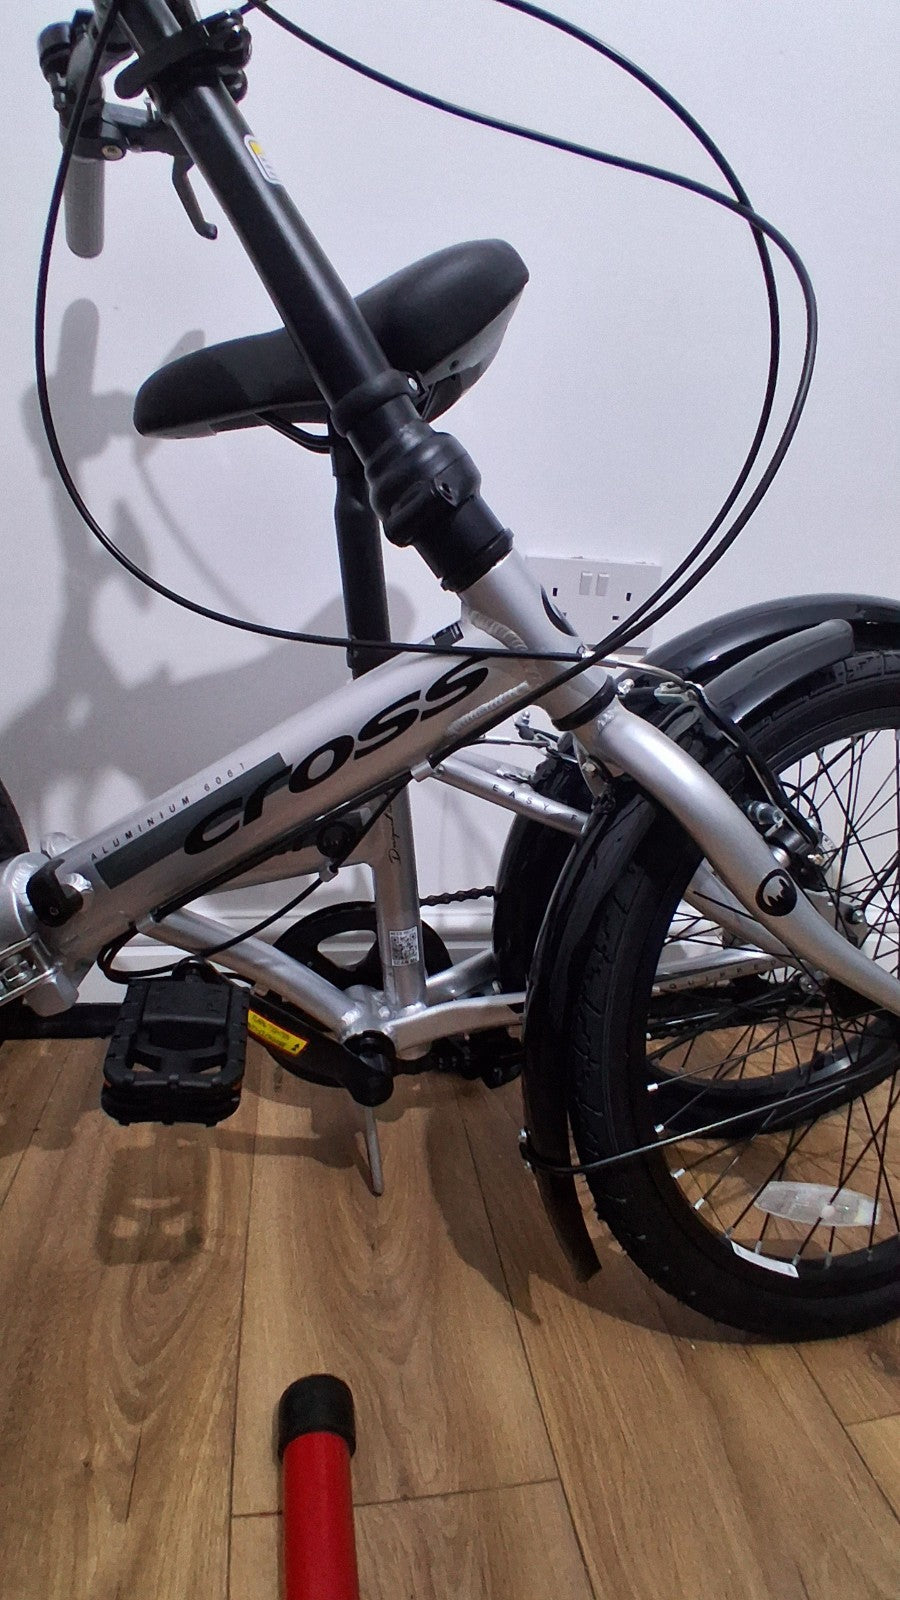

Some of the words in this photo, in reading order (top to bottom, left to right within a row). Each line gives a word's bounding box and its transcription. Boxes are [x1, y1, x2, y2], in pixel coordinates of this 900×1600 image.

[91, 796, 190, 862] ALUMINIUM
[204, 762, 246, 792] 6061
[492, 784, 550, 812] EASY
